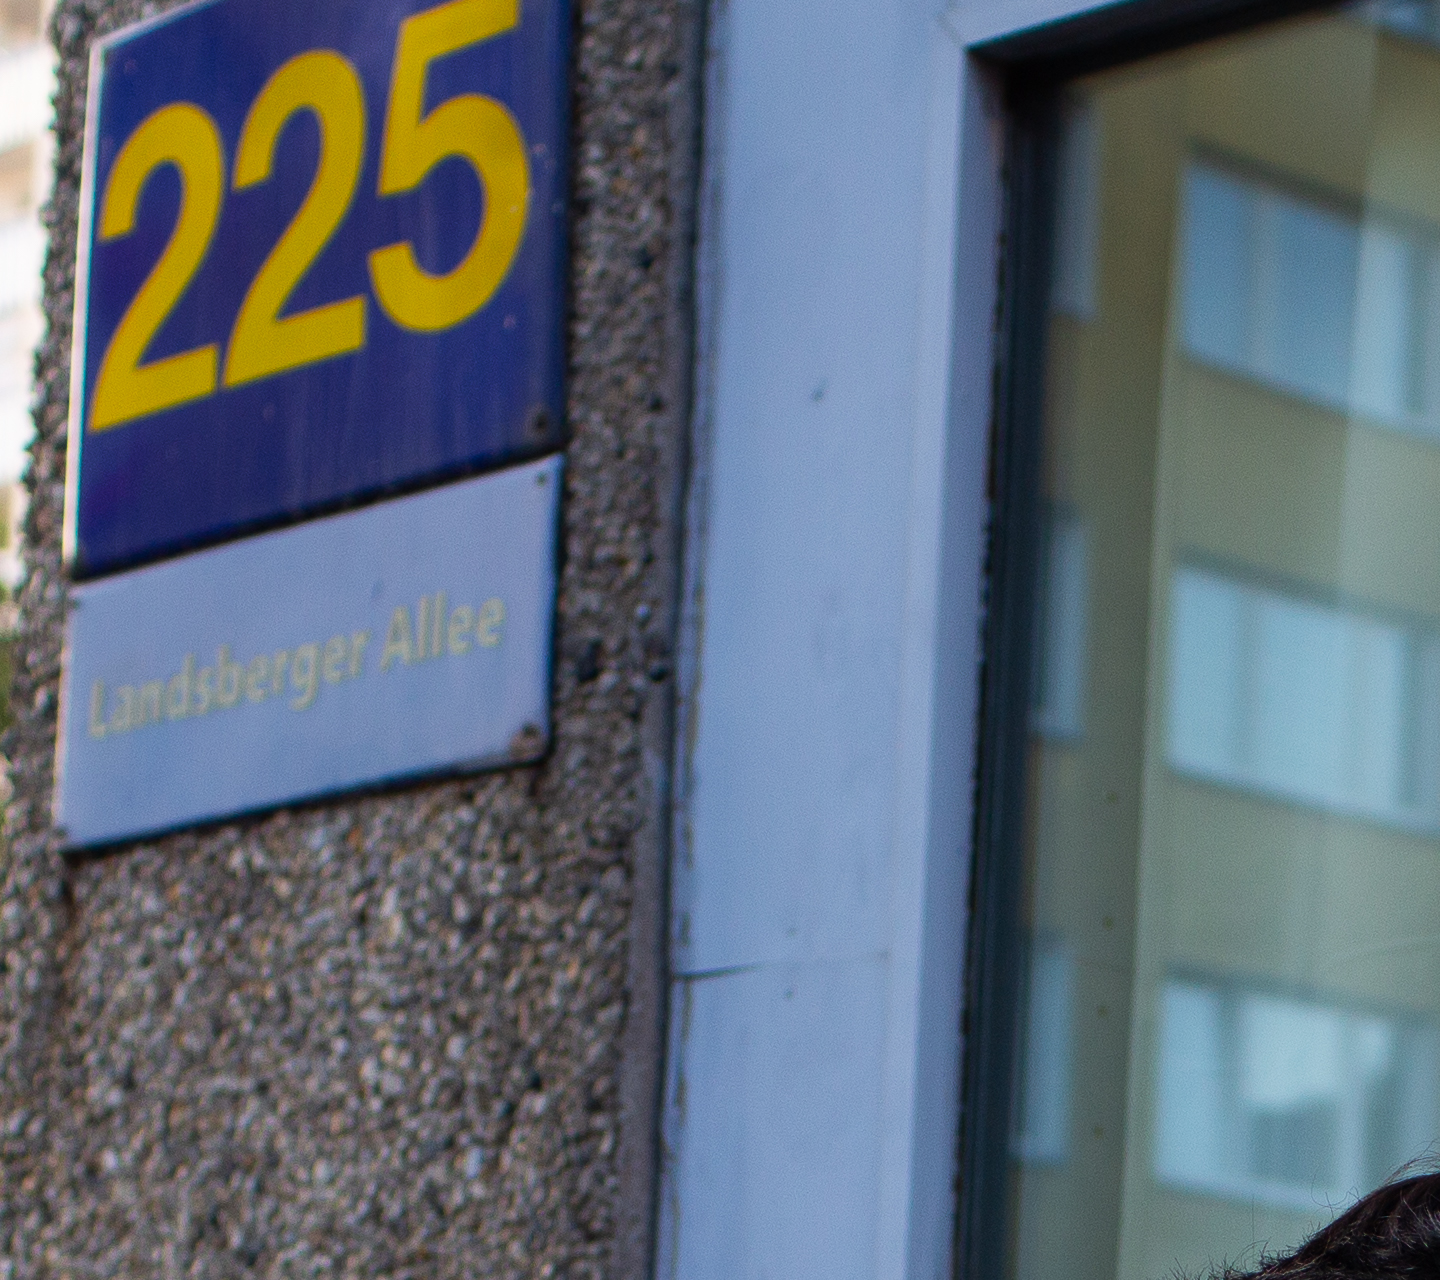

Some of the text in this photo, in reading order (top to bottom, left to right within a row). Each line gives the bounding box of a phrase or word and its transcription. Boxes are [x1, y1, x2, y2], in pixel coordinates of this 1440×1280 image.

[88, 0, 529, 432] 225
[88, 590, 507, 739] Landsberger Allee
